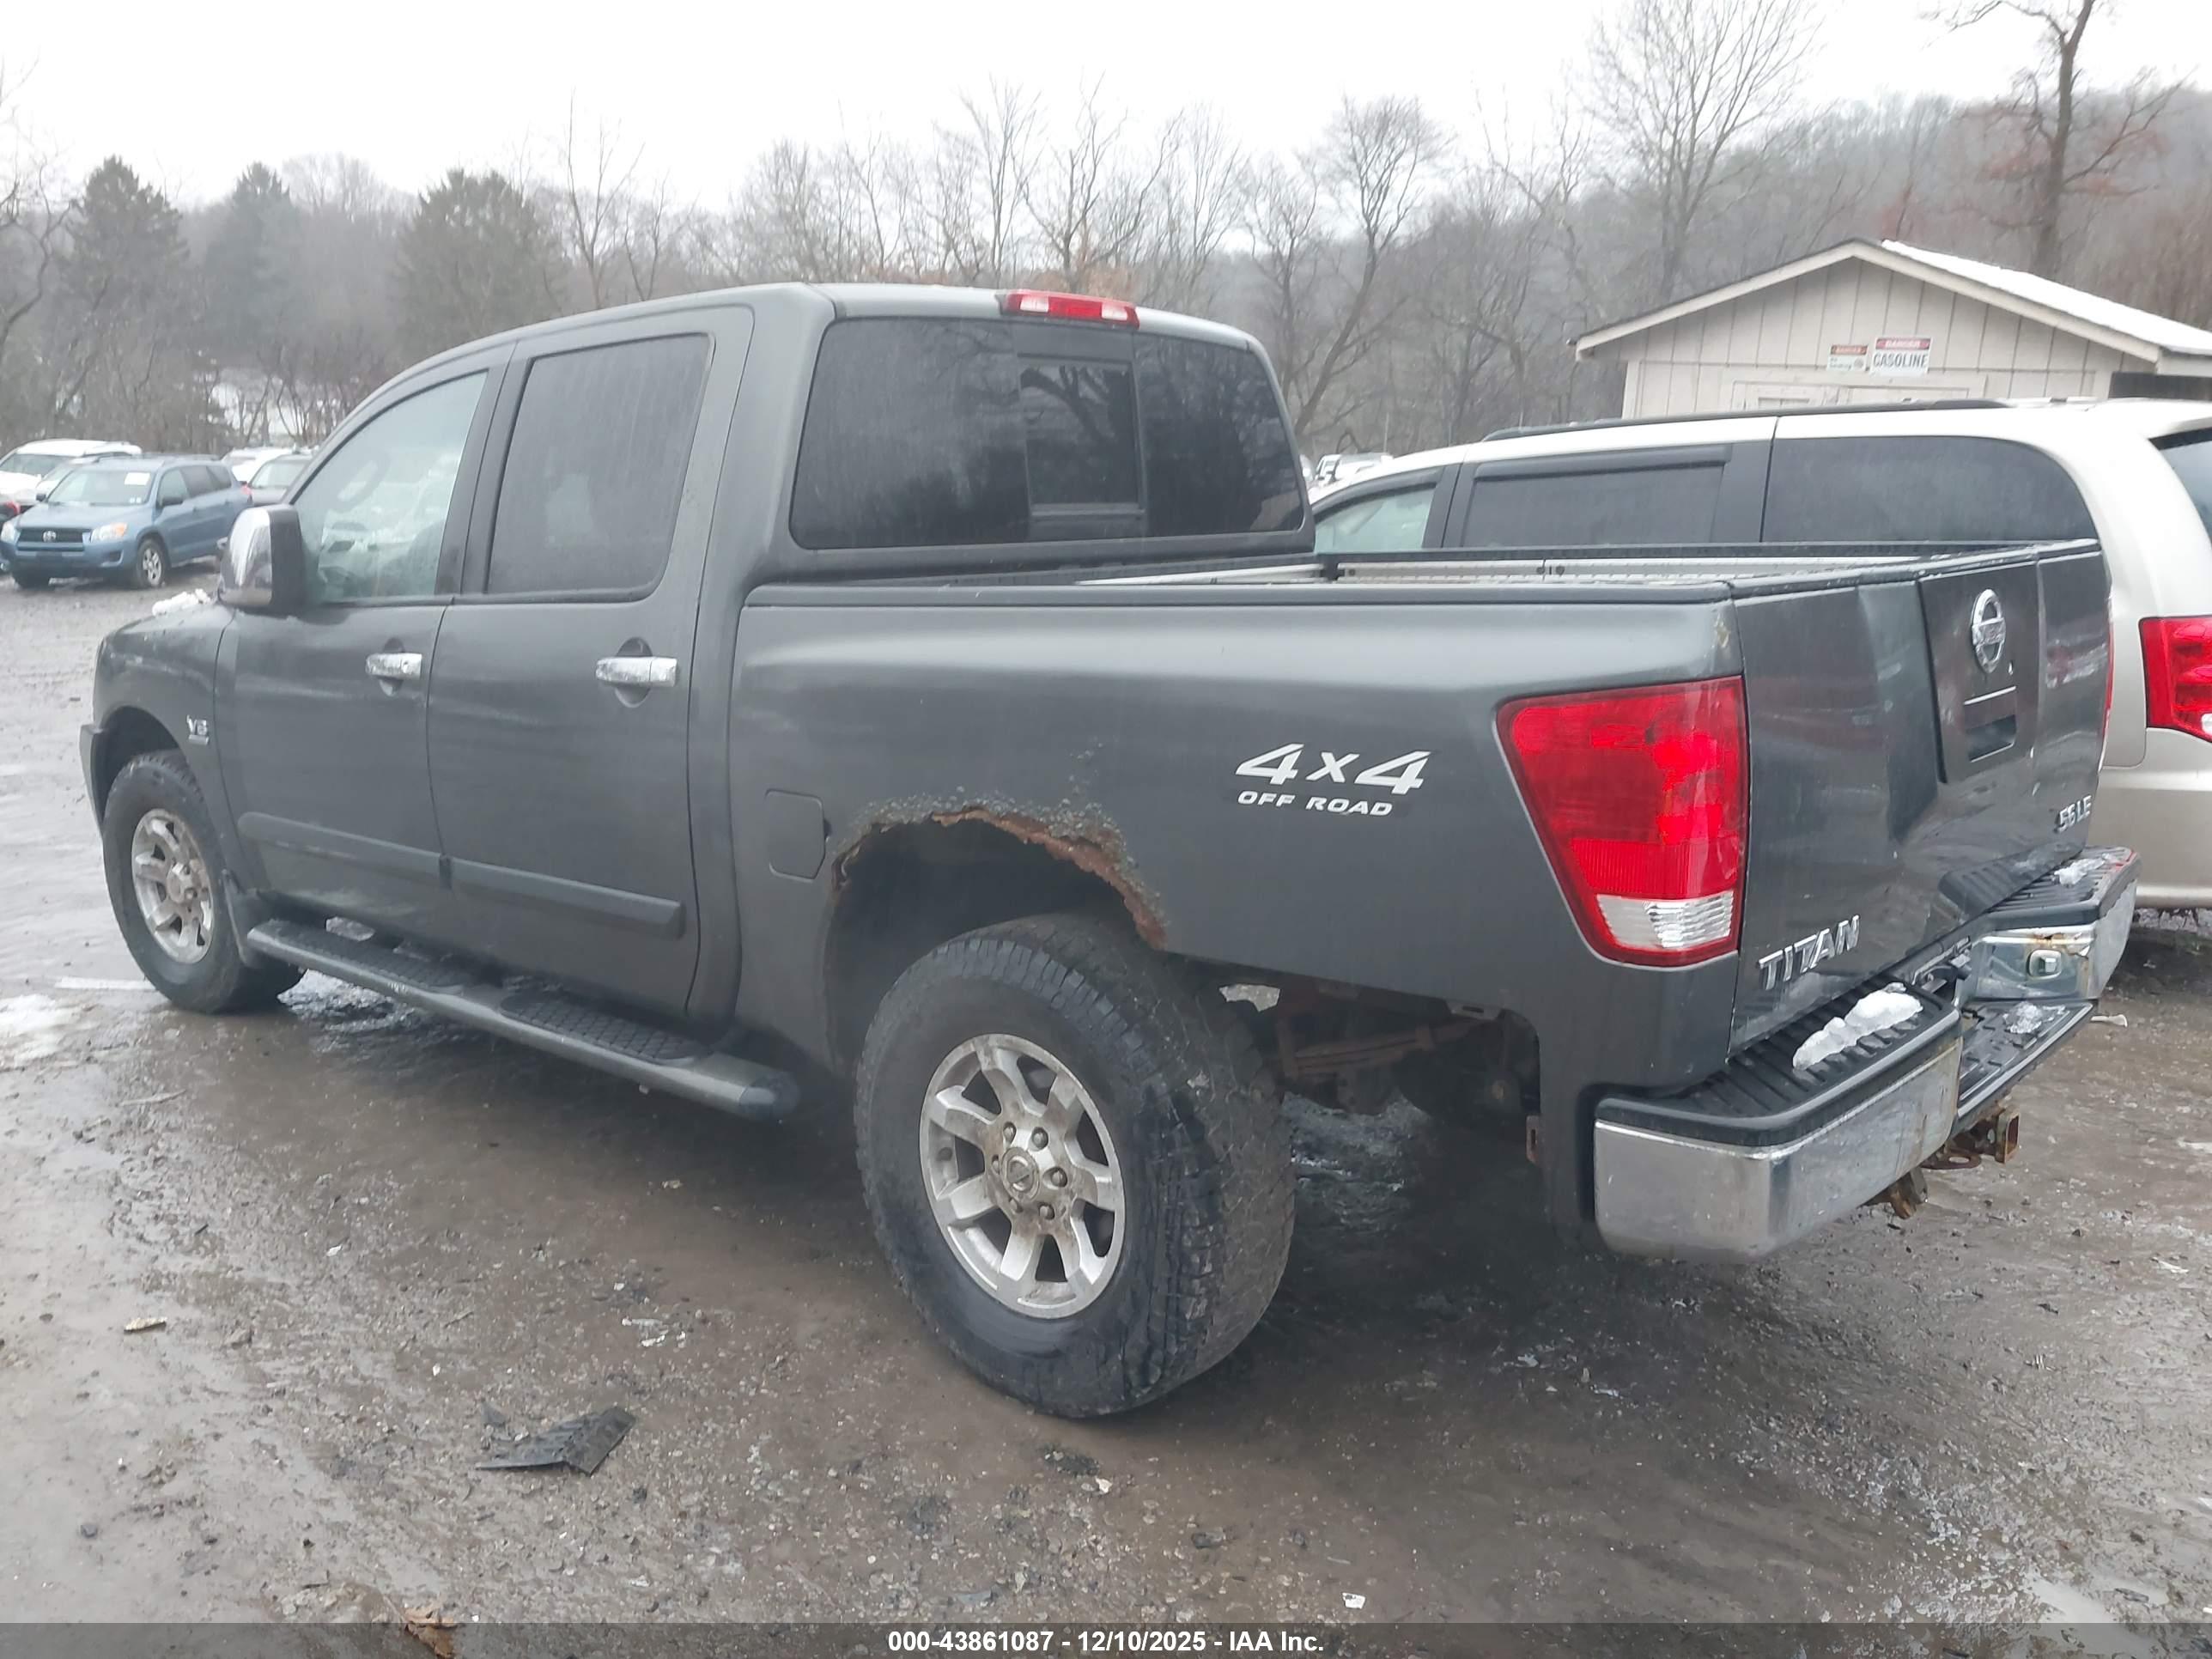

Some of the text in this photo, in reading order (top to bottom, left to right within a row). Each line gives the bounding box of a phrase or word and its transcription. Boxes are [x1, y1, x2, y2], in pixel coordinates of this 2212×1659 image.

[1873, 353, 1929, 368] GASOLINE
[1237, 791, 1393, 816] OFF ROAD
[1759, 915, 1860, 991] TITAN
